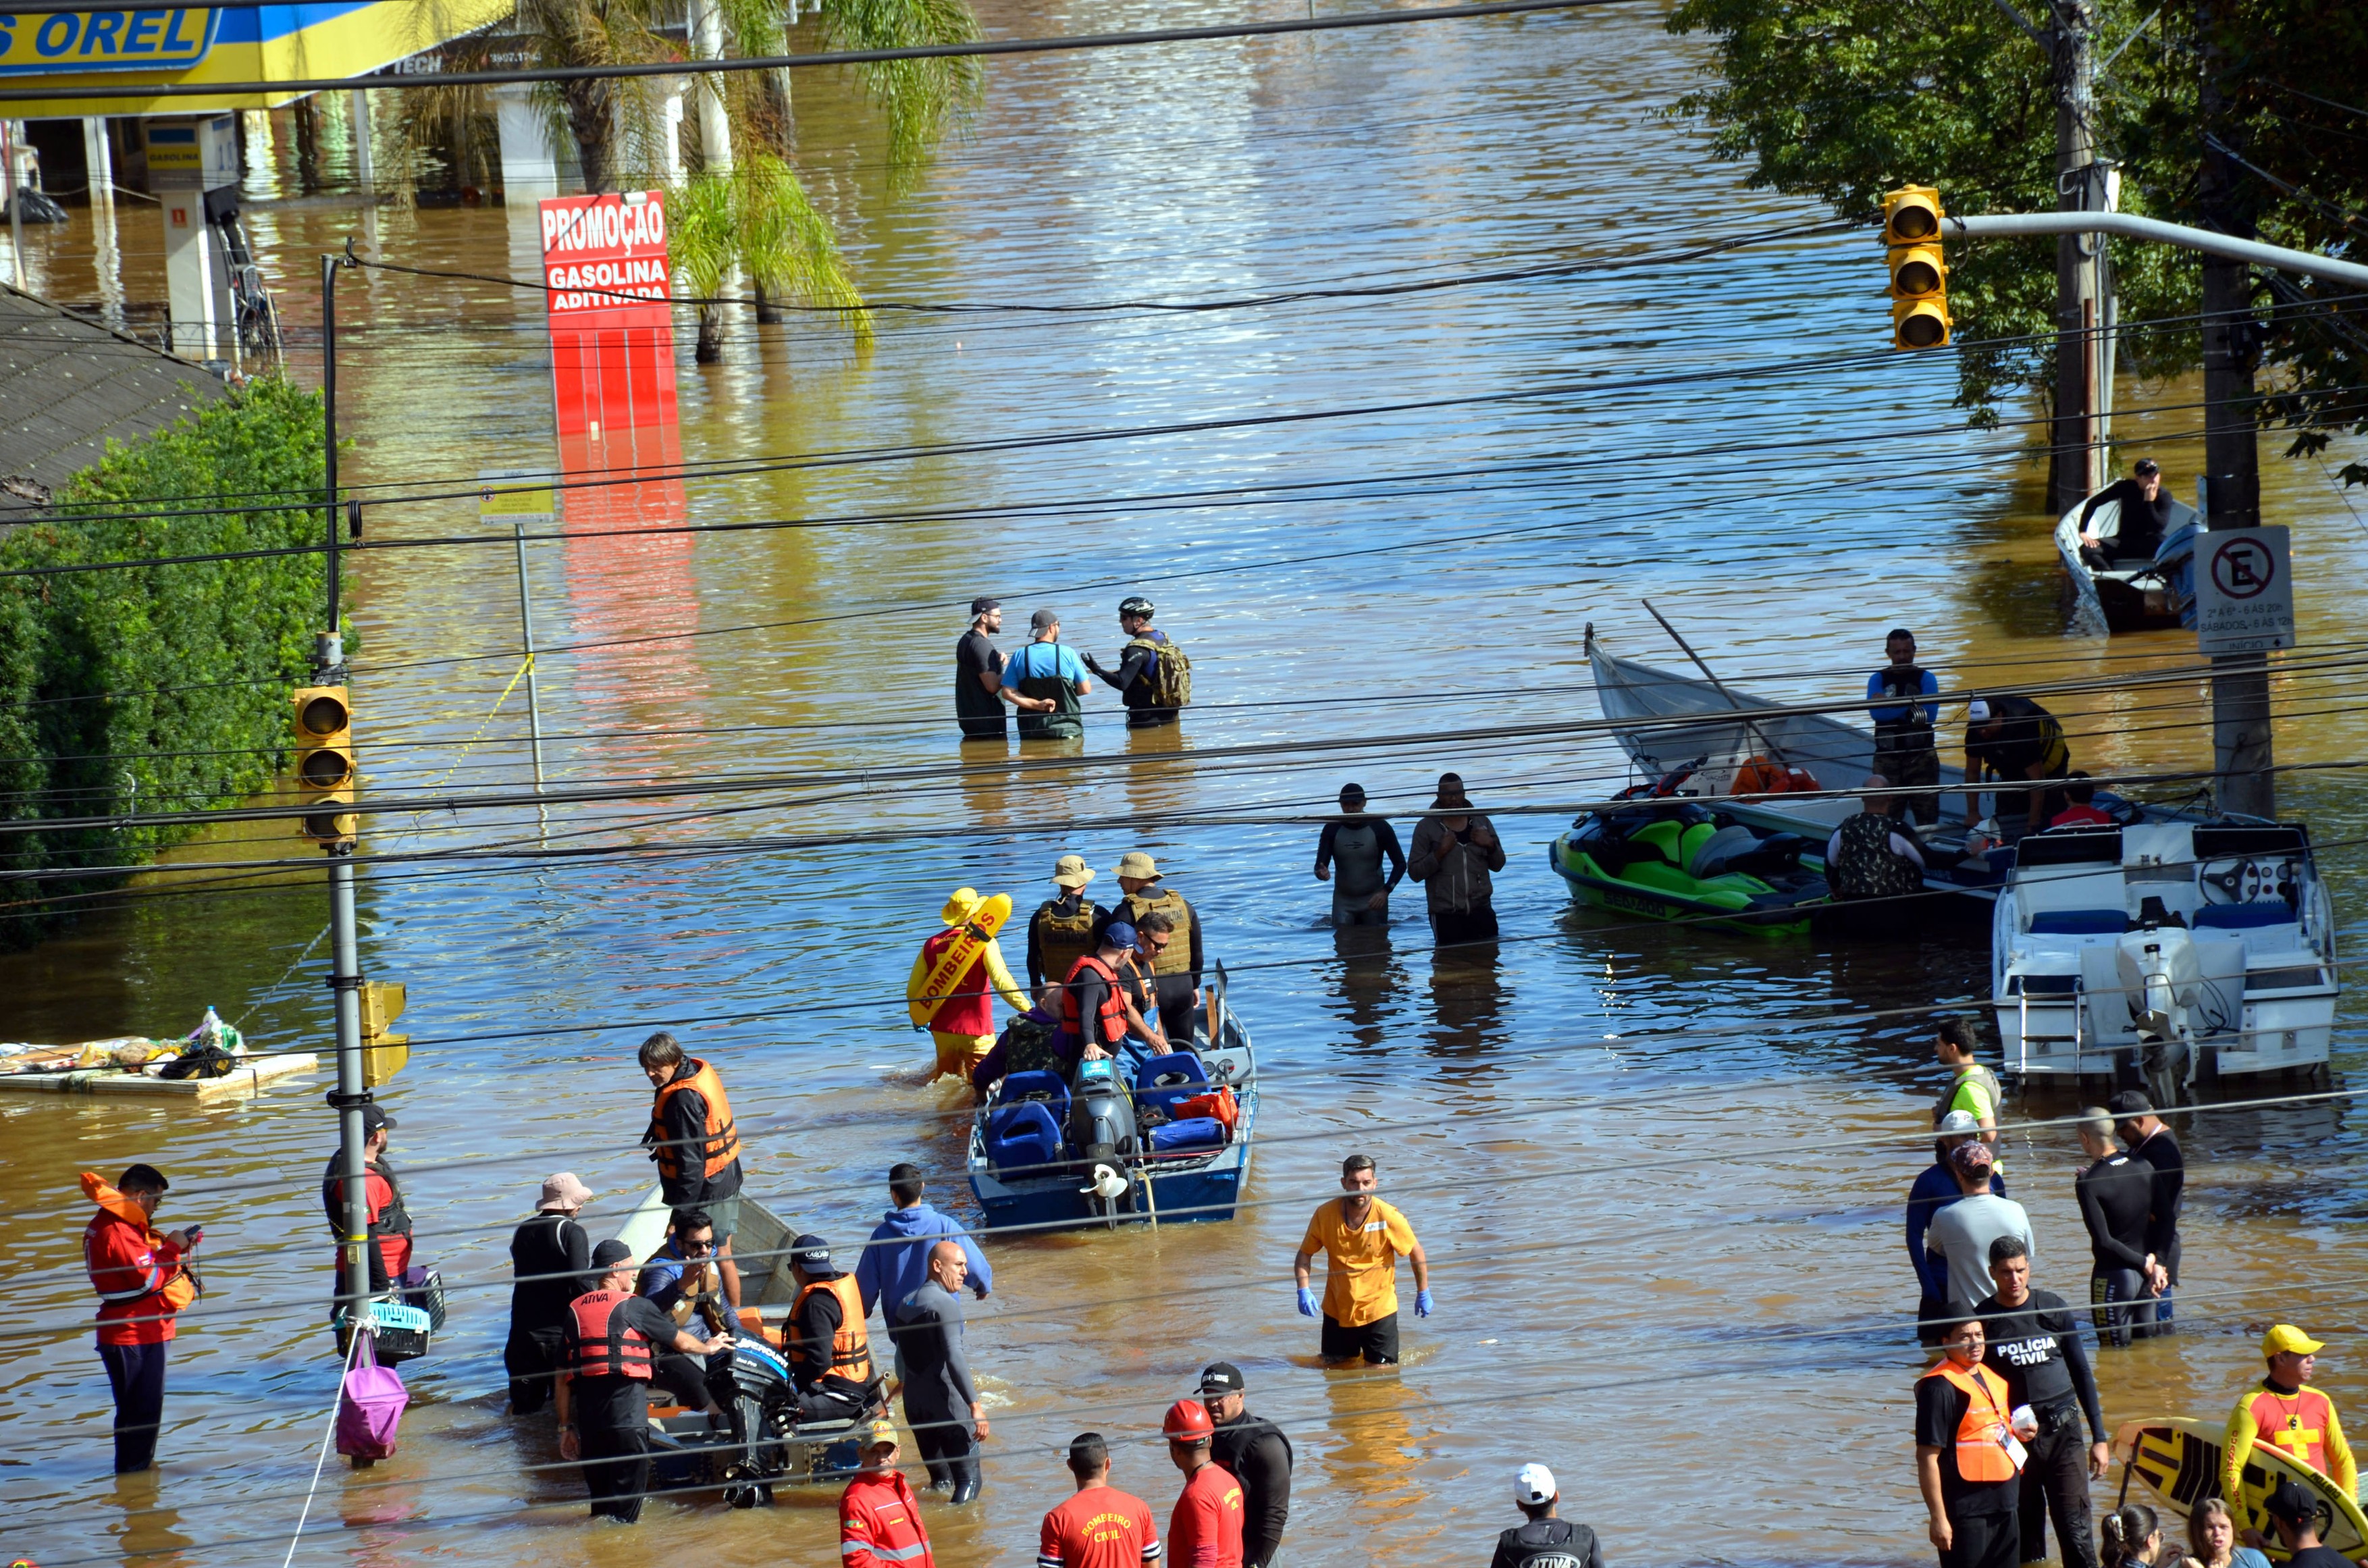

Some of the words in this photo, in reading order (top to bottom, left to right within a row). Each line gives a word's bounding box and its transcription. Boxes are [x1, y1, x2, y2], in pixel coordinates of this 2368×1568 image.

[36, 9, 194, 57] OREL
[394, 55, 442, 74] TECH
[150, 153, 199, 161] GASOLINA
[550, 259, 666, 289] GASOLINA
[554, 286, 665, 310] ADITIVADA
[2244, 606, 2250, 615] 6
[2267, 604, 2283, 613] 20h
[2254, 619, 2260, 628] 6
[2278, 616, 2293, 626] 12h
[2229, 640, 2263, 650] INÍCIO
[935, 936, 957, 945] GUARD
[581, 1293, 608, 1305] ATIVA
[736, 1338, 789, 1368] MERCURY
[1997, 1336, 2057, 1357] POLÍCIA
[2011, 1350, 2050, 1366] CIVIL
[2309, 1471, 2342, 1499] CUSTOM
[1082, 1513, 1131, 1537] BOMBEIRO
[1094, 1530, 1122, 1543] CIVIL
